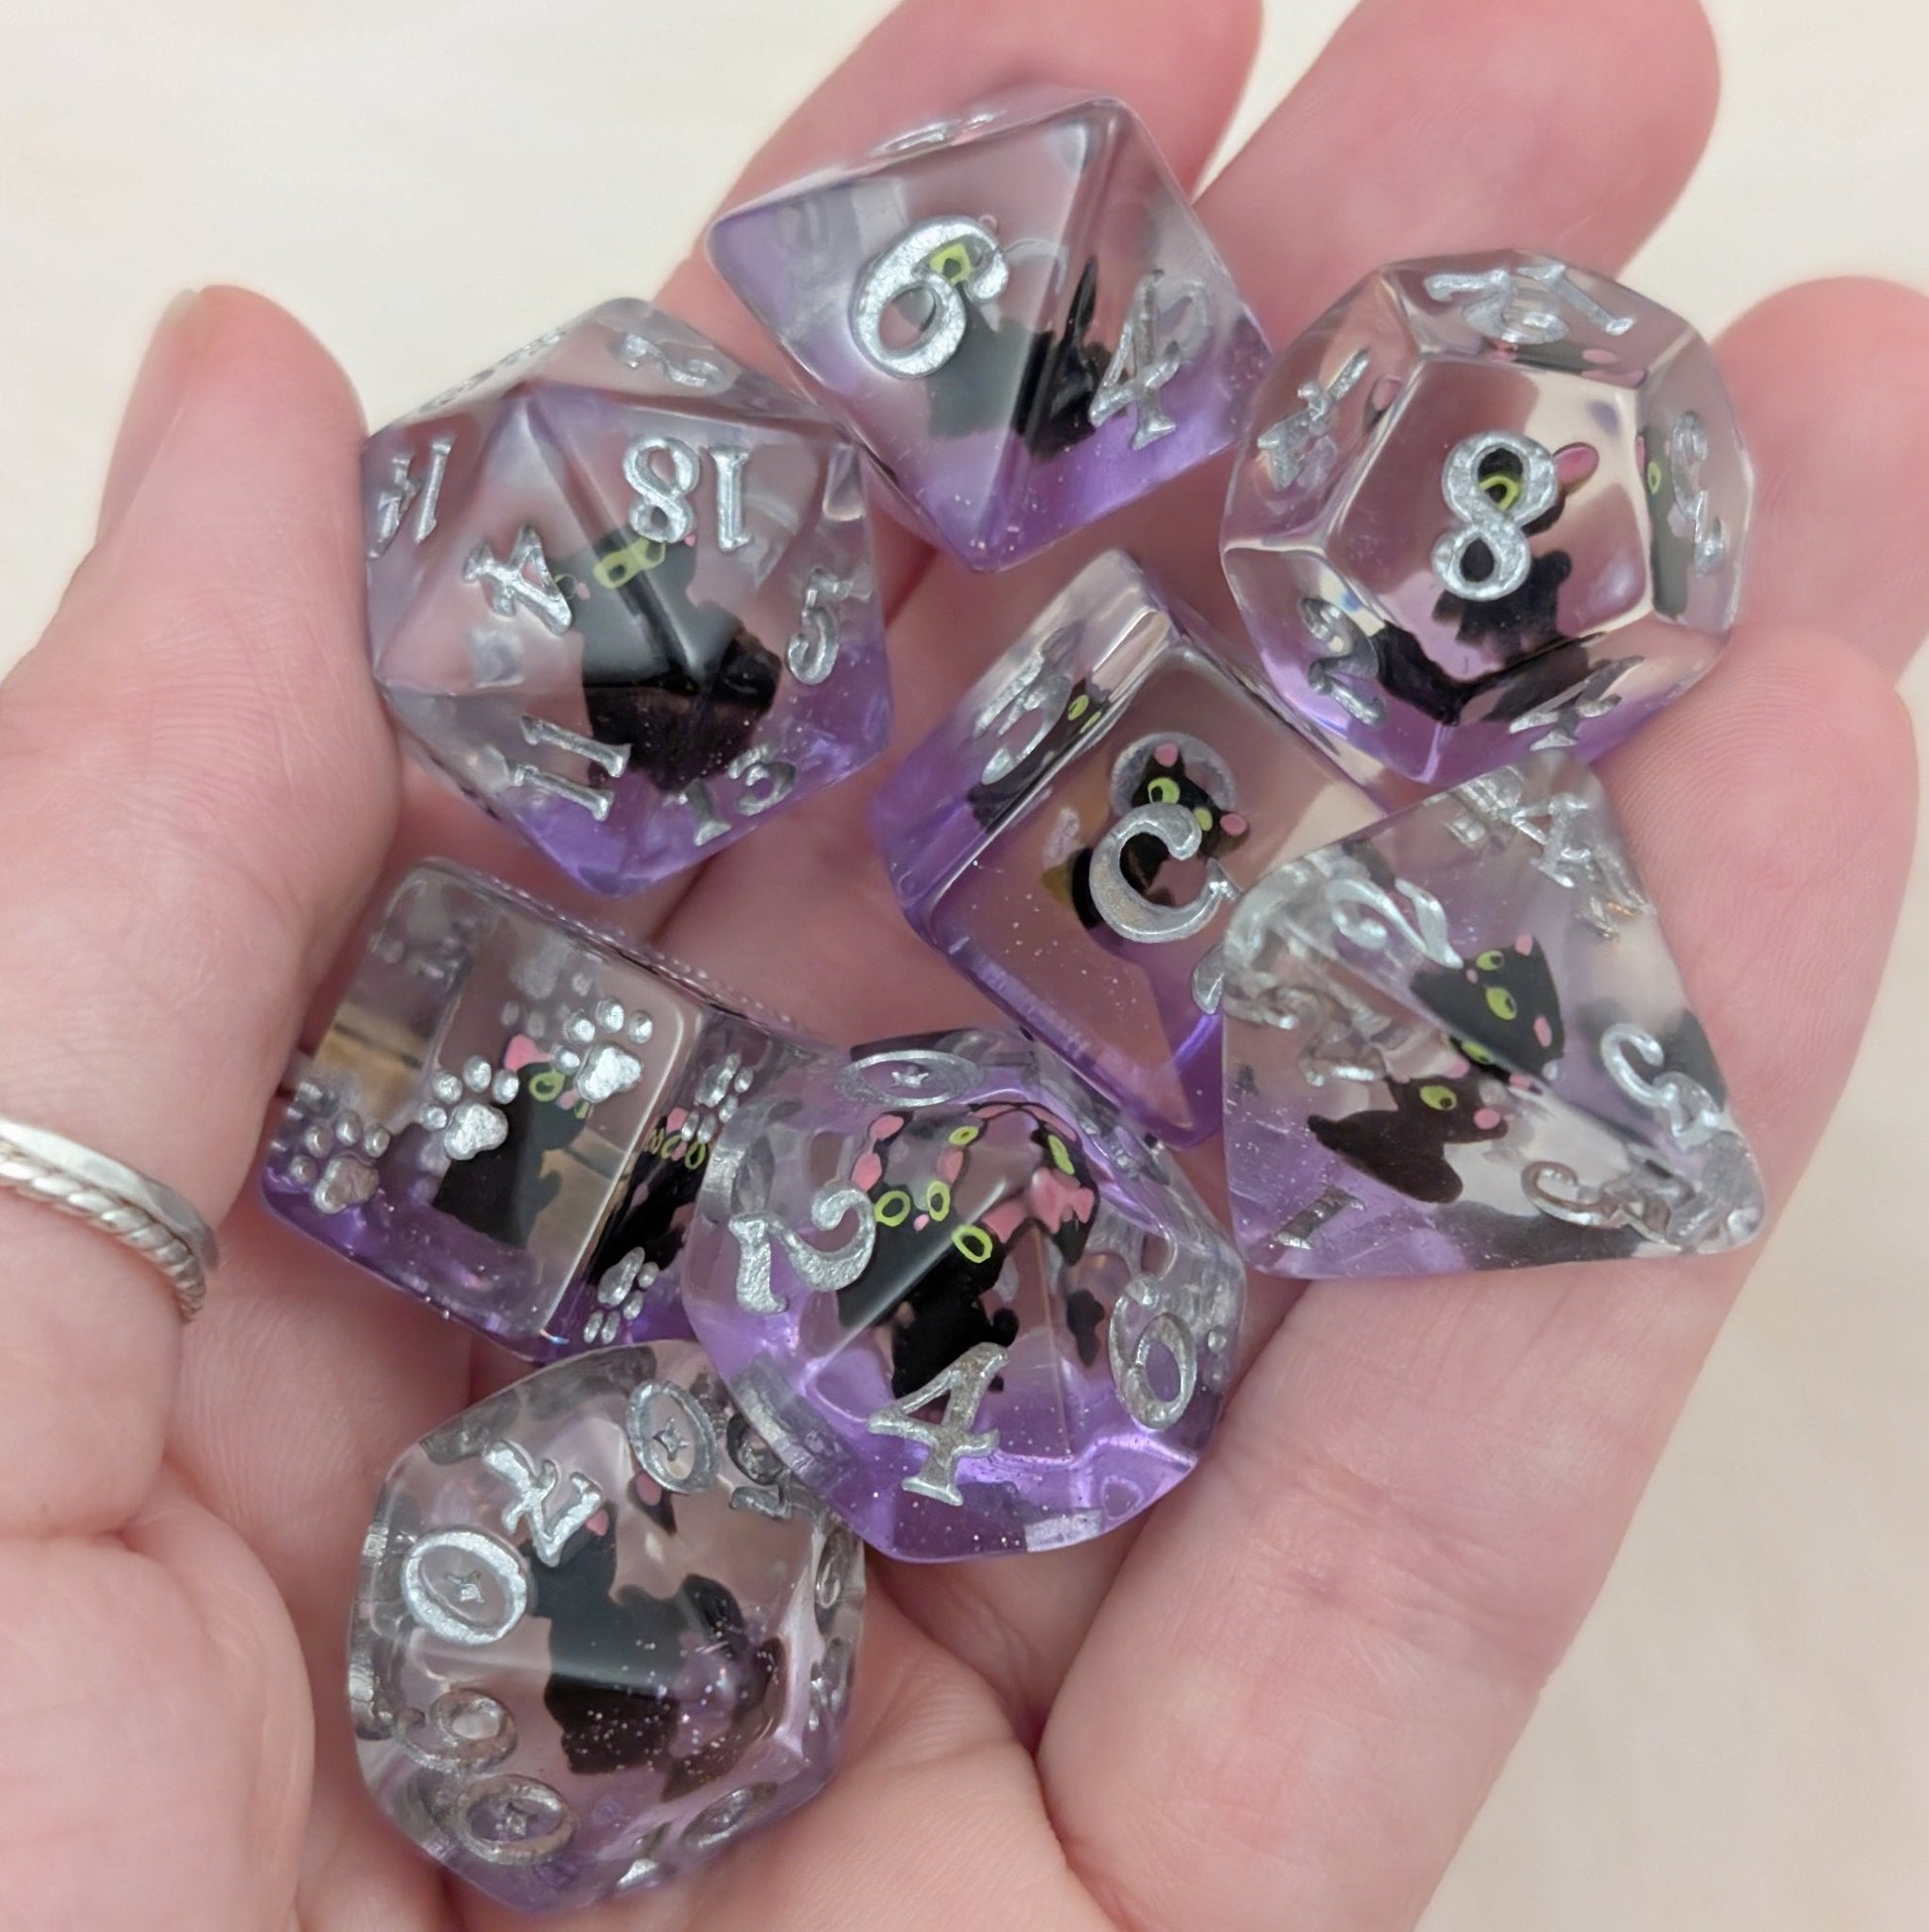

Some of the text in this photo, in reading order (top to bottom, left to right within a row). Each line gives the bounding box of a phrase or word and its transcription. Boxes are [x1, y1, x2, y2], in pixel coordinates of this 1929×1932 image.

[850, 215, 1009, 379] 6
[1090, 269, 1177, 451] 4
[624, 434, 752, 552] 18
[1431, 430, 1560, 602] 8
[463, 525, 573, 636] 4
[728, 1180, 877, 1314] 2
[866, 1341, 1010, 1507] 4
